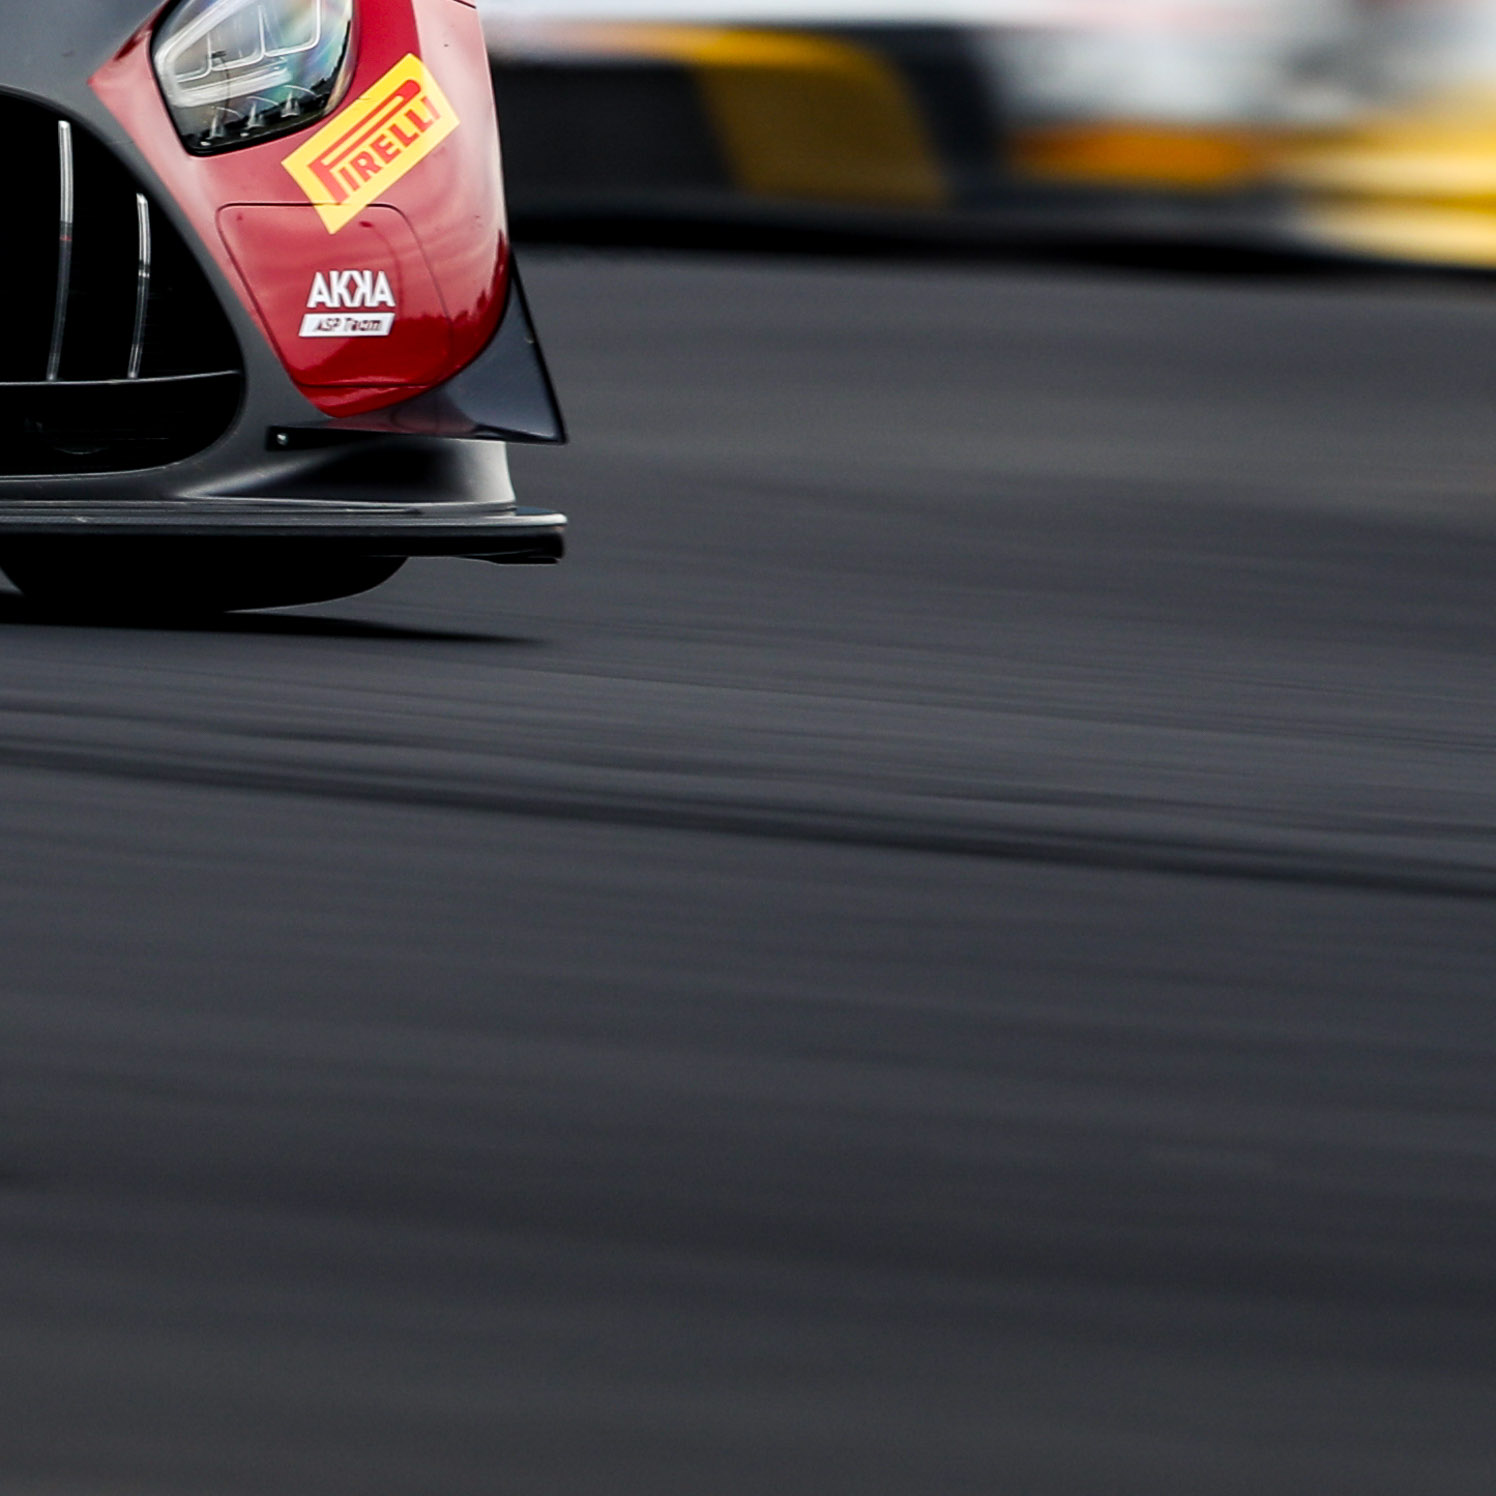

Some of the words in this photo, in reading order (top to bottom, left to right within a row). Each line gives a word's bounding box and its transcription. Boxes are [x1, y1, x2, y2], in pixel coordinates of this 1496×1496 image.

[307, 78, 441, 206] PIRELLI
[307, 270, 396, 308] AKKA
[316, 317, 341, 332] ASP
[346, 317, 383, 332] Team
